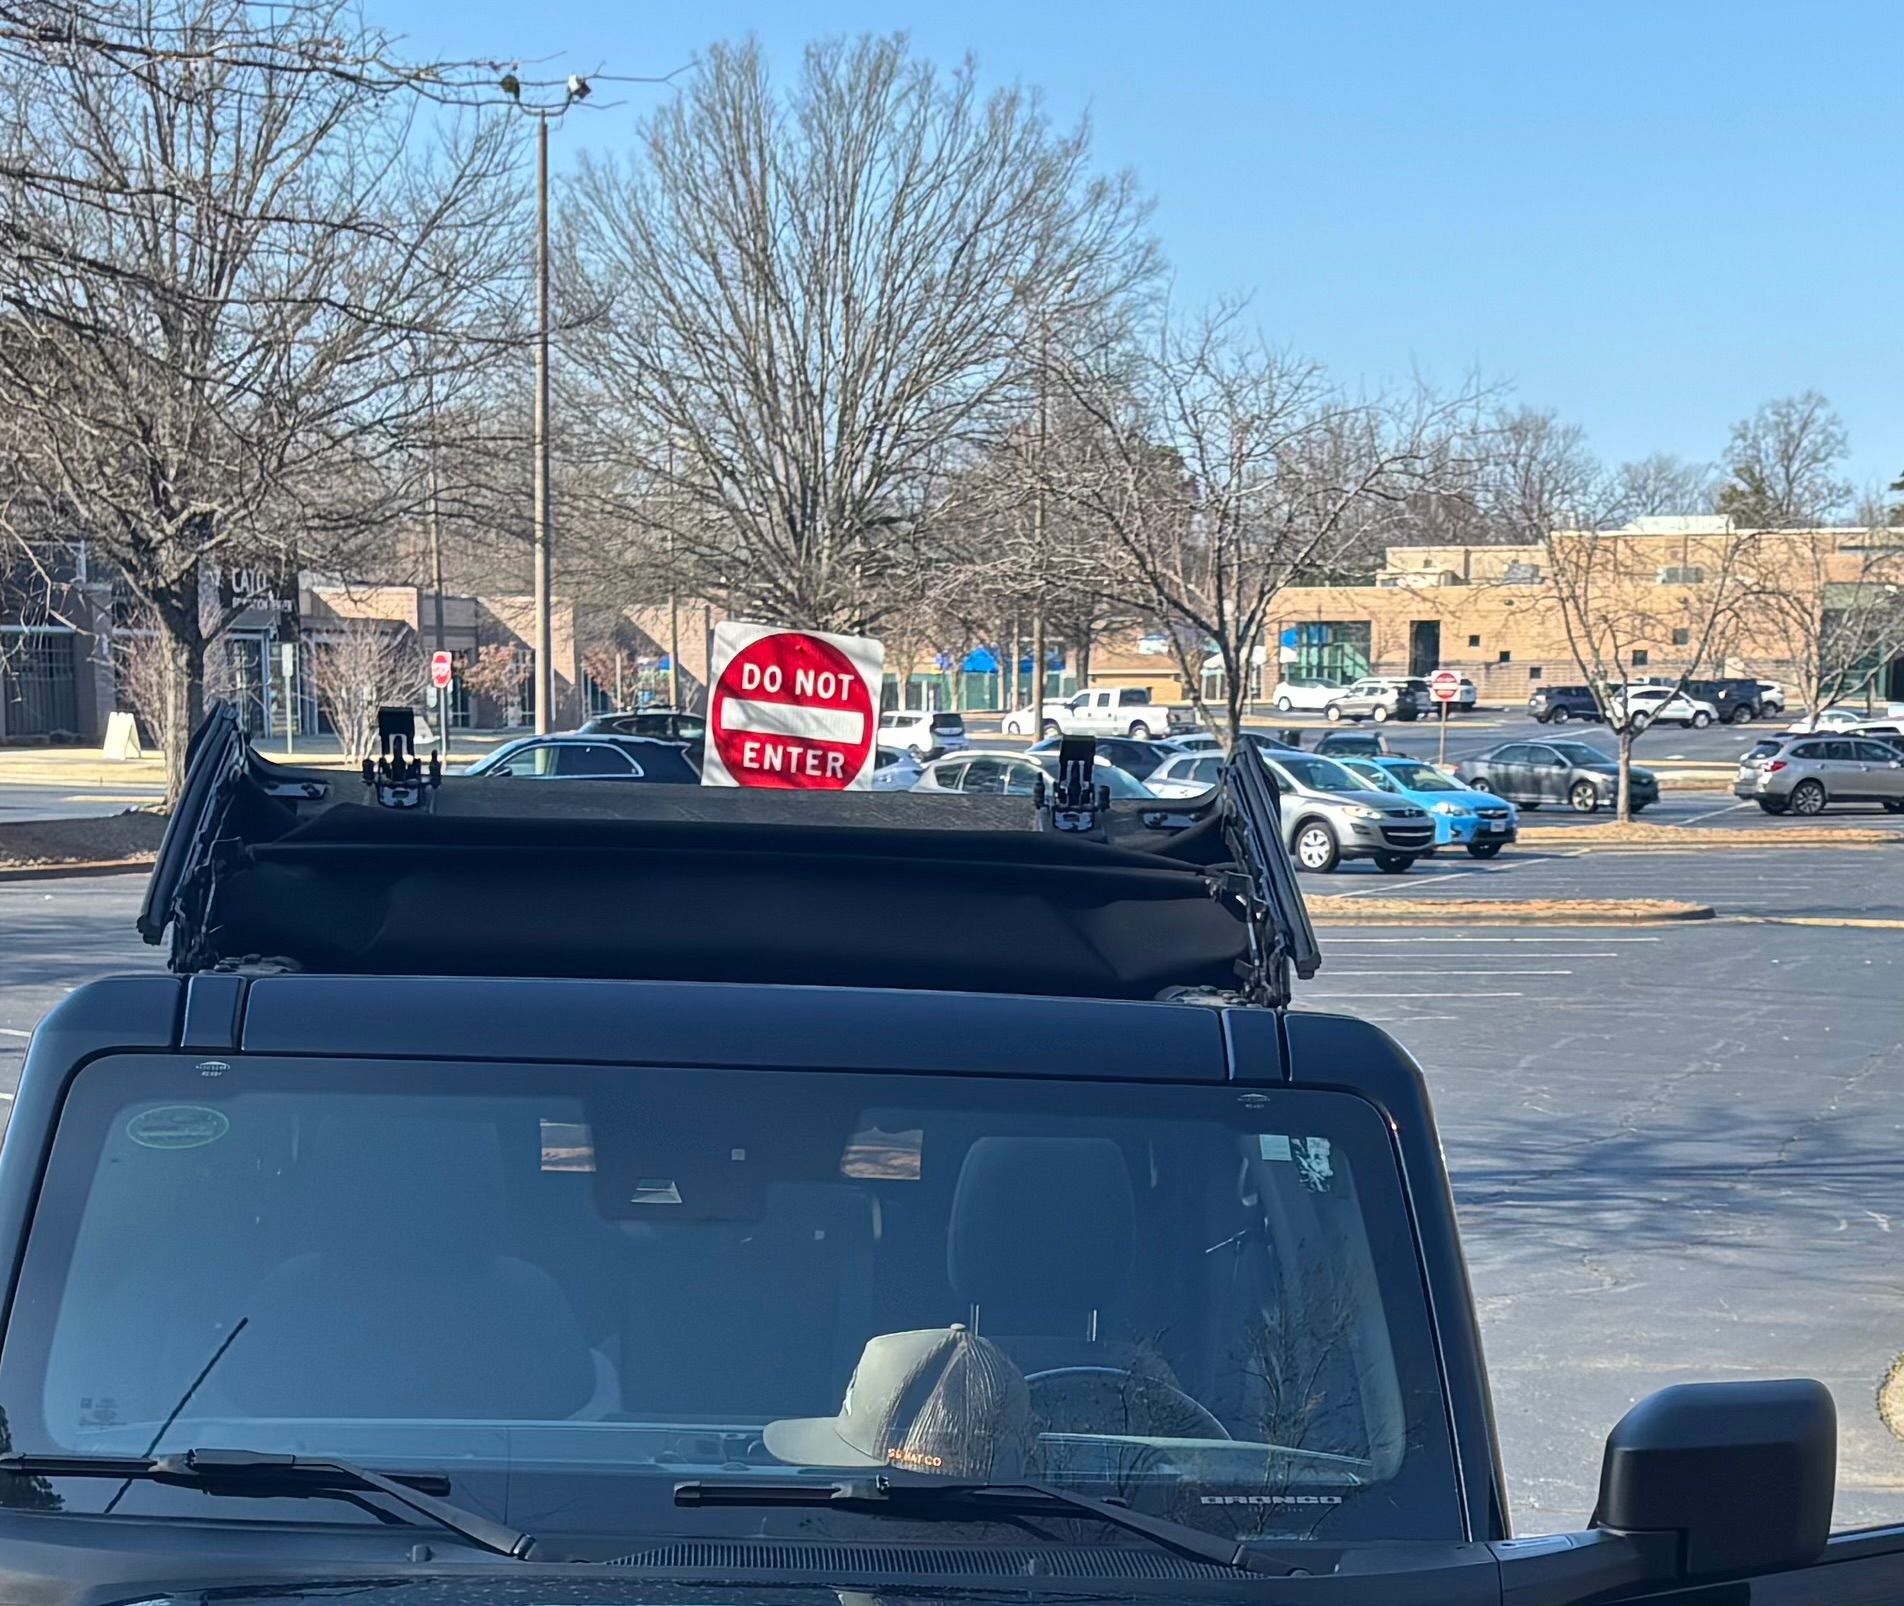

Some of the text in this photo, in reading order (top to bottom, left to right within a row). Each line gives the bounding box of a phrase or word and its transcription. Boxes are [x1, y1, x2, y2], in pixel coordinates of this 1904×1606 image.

[741, 662, 855, 701] DO NOT
[743, 742, 845, 778] ENTER
[924, 1455, 942, 1467] CO
